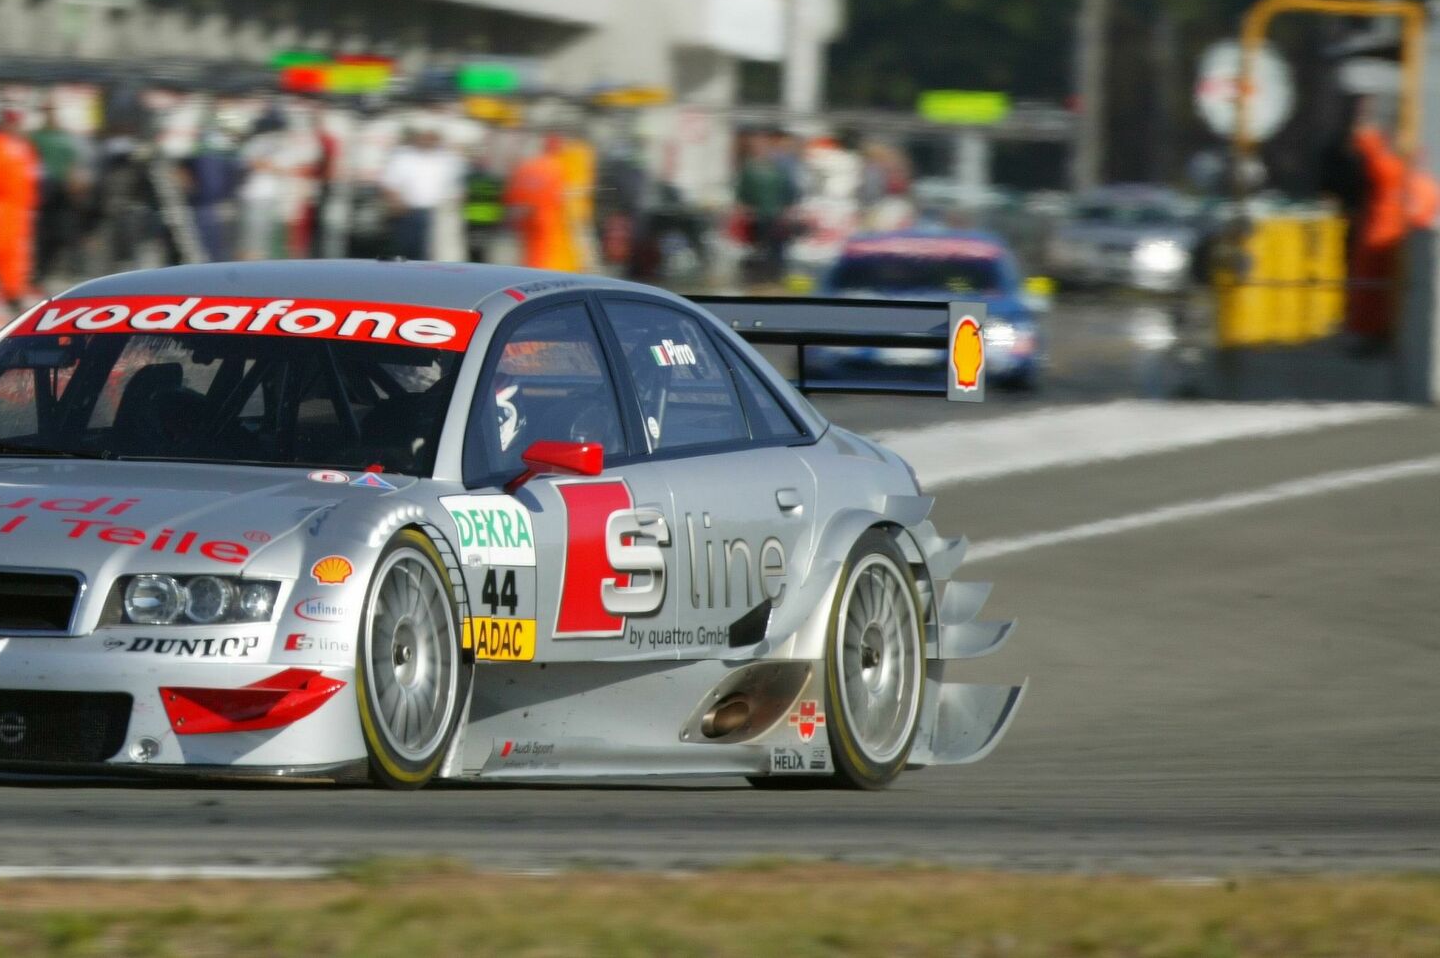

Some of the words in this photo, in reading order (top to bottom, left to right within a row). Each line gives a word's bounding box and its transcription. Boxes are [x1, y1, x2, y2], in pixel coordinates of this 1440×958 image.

[34, 297, 457, 344] vodafone
[662, 339, 696, 365] Pirro
[451, 509, 533, 548] DEKRA
[685, 512, 787, 609] line
[481, 569, 518, 615] 44
[126, 636, 259, 658] DUNLOP
[319, 637, 350, 652] line
[476, 620, 523, 657] ADAC
[630, 626, 644, 650] by
[649, 627, 694, 650] quattro
[774, 755, 806, 770] HELIX
